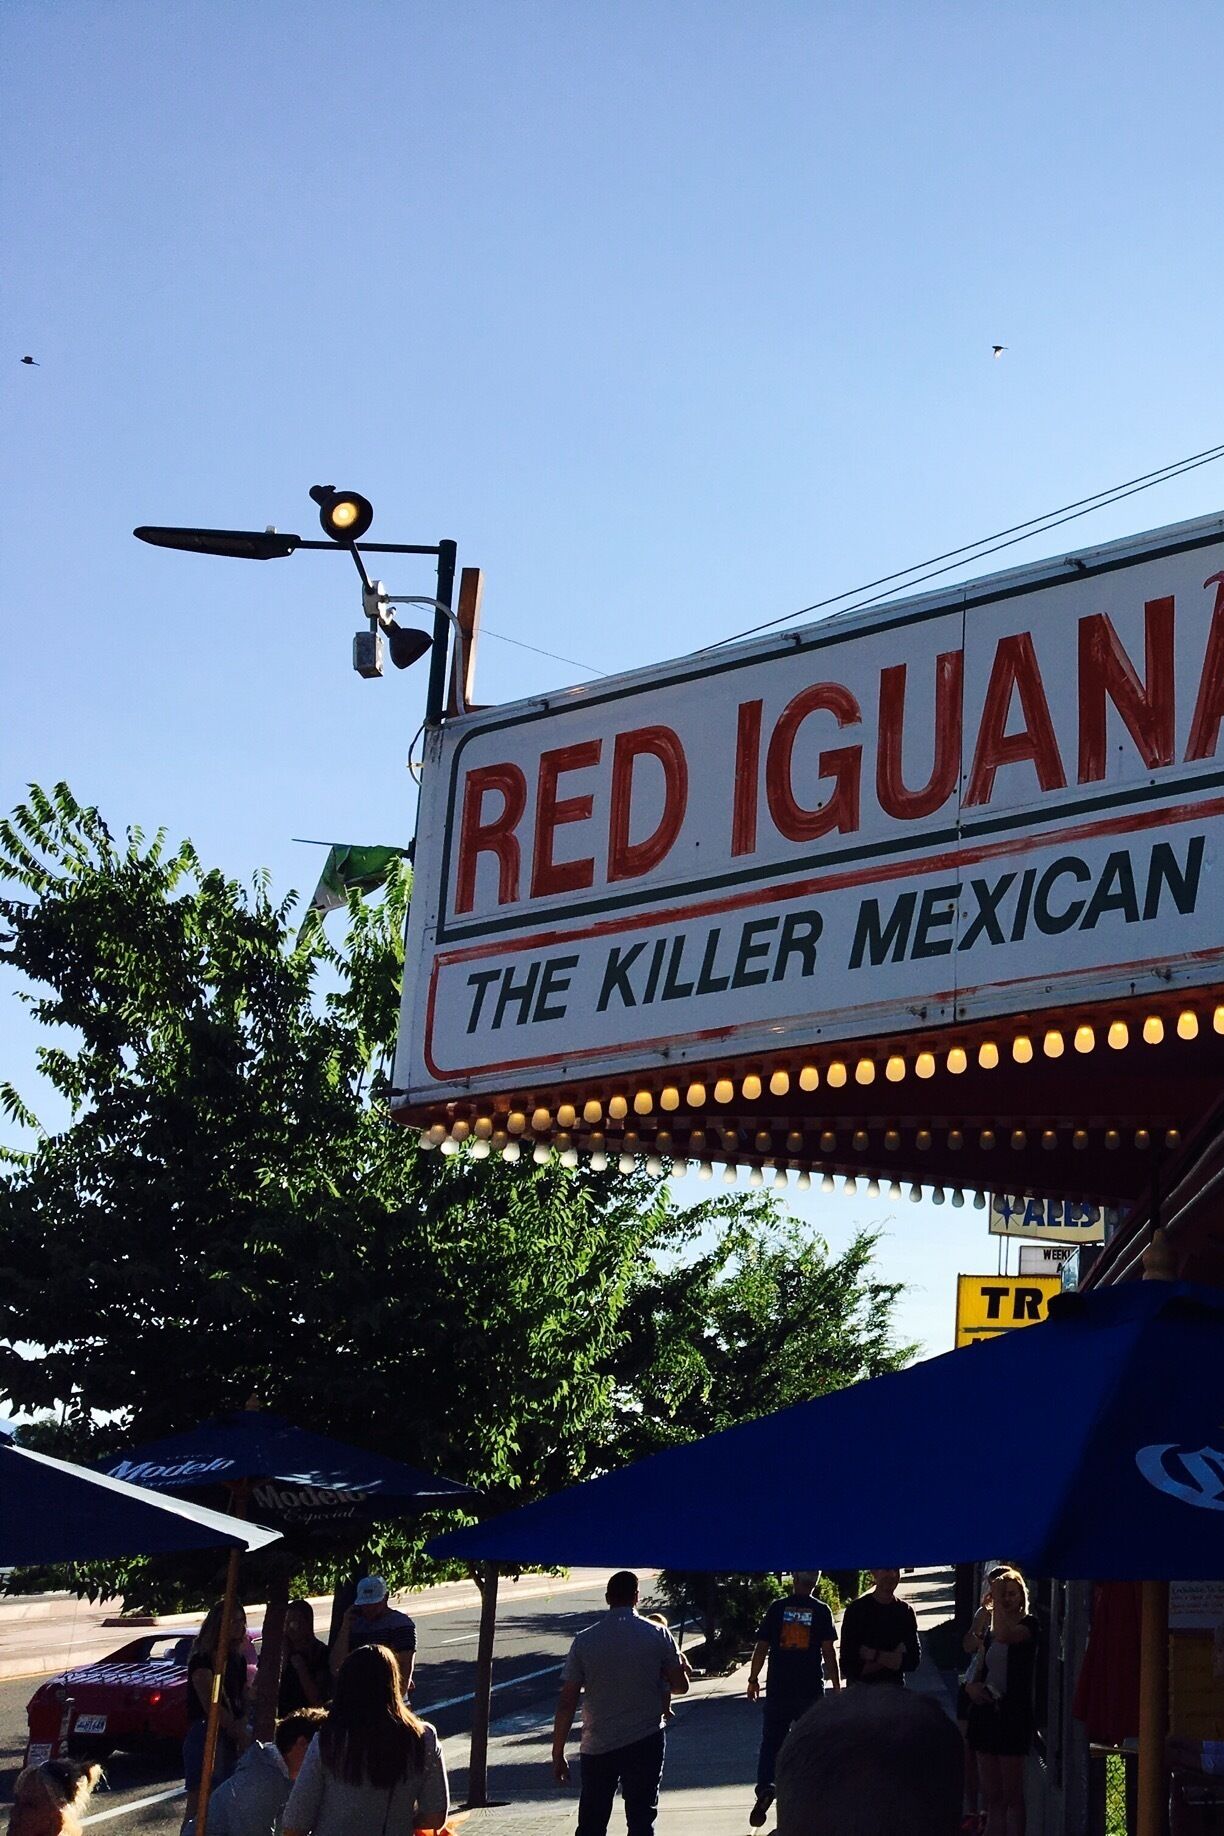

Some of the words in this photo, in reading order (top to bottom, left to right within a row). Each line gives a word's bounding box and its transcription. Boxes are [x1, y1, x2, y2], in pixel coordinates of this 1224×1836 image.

[455, 724, 689, 915] RED
[466, 954, 578, 1034] THE
[596, 908, 822, 1011] KILLER
[848, 835, 1205, 970] MEXICAN
[106, 1457, 236, 1481] Modelo
[252, 1484, 369, 1509] Modelo
